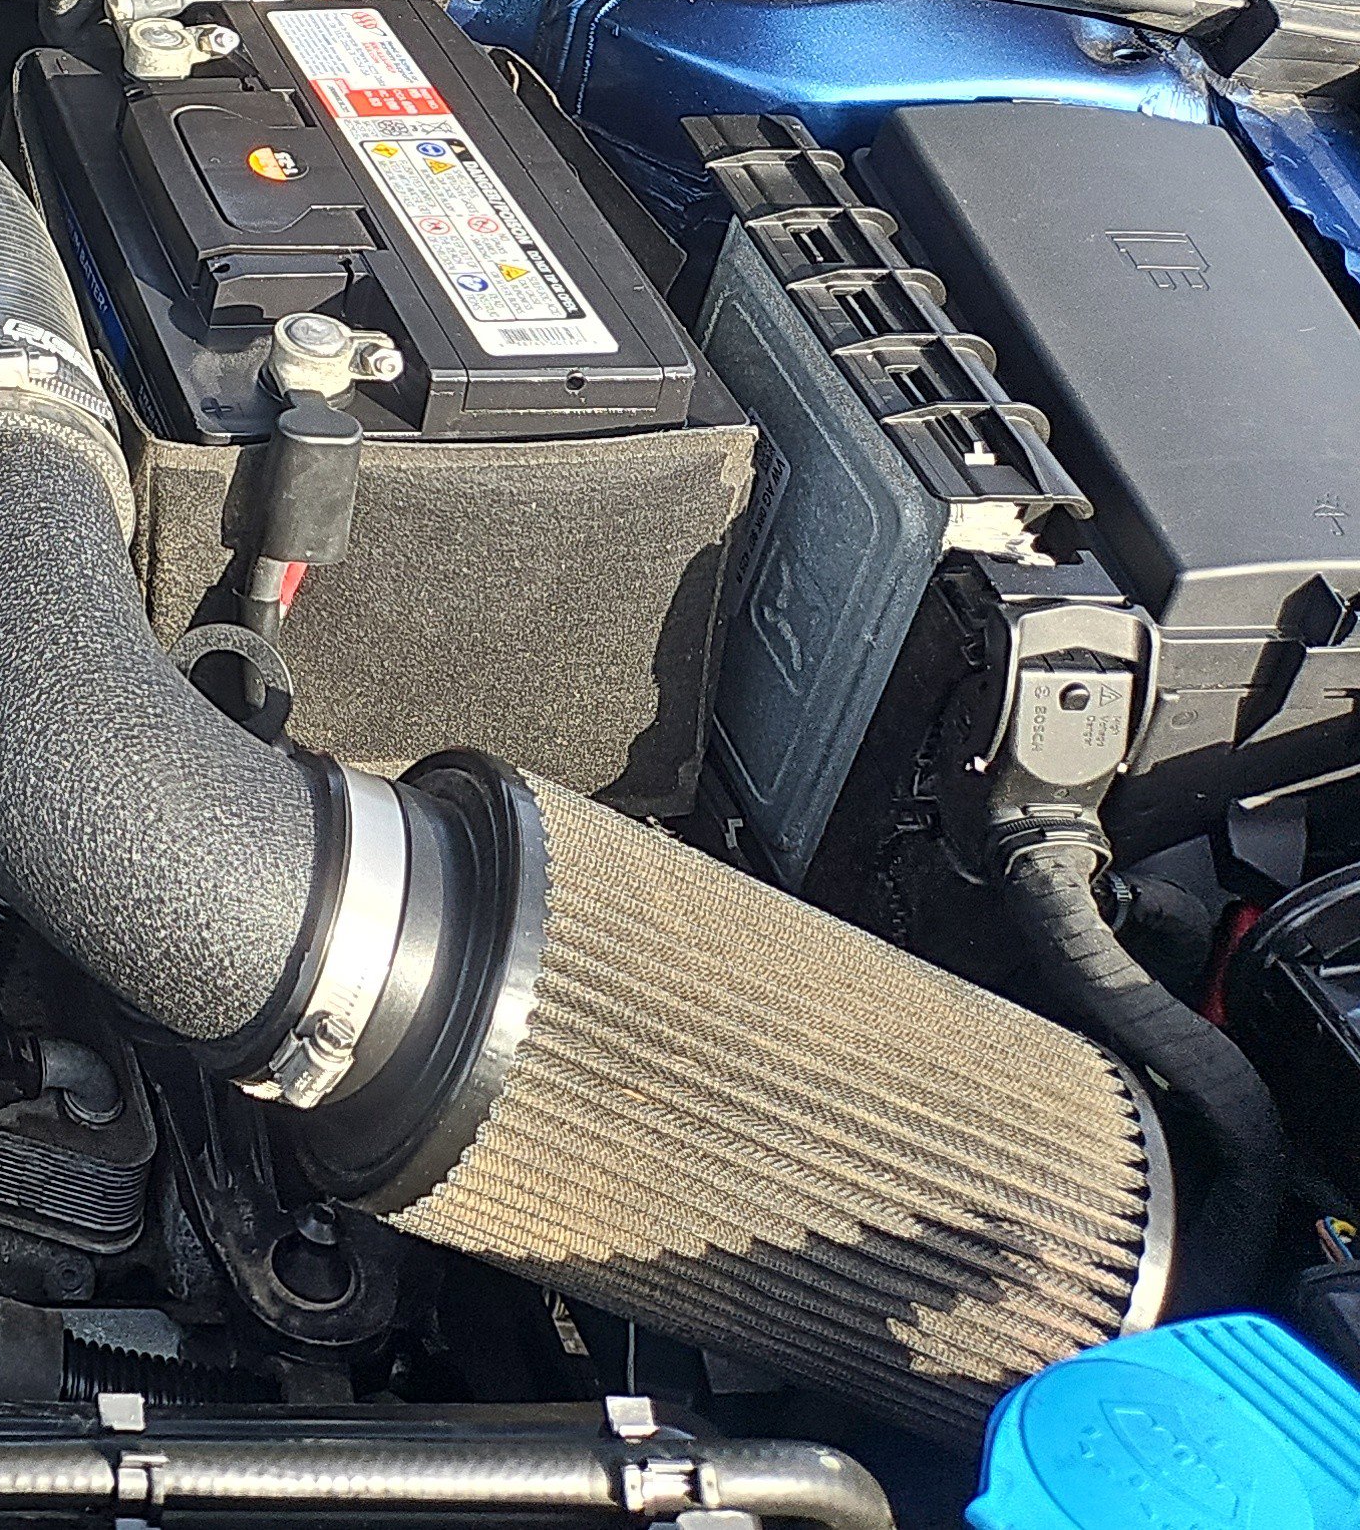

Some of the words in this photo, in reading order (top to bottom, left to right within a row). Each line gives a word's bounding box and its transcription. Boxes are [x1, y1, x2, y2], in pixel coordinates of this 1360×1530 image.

[460, 160, 535, 245] DANGER/POISON
[525, 250, 543, 260] DO
[532, 260, 553, 273] NOT
[541, 273, 560, 283] TIP
[548, 282, 567, 294] OR
[1031, 706, 1047, 752] BOSCH
